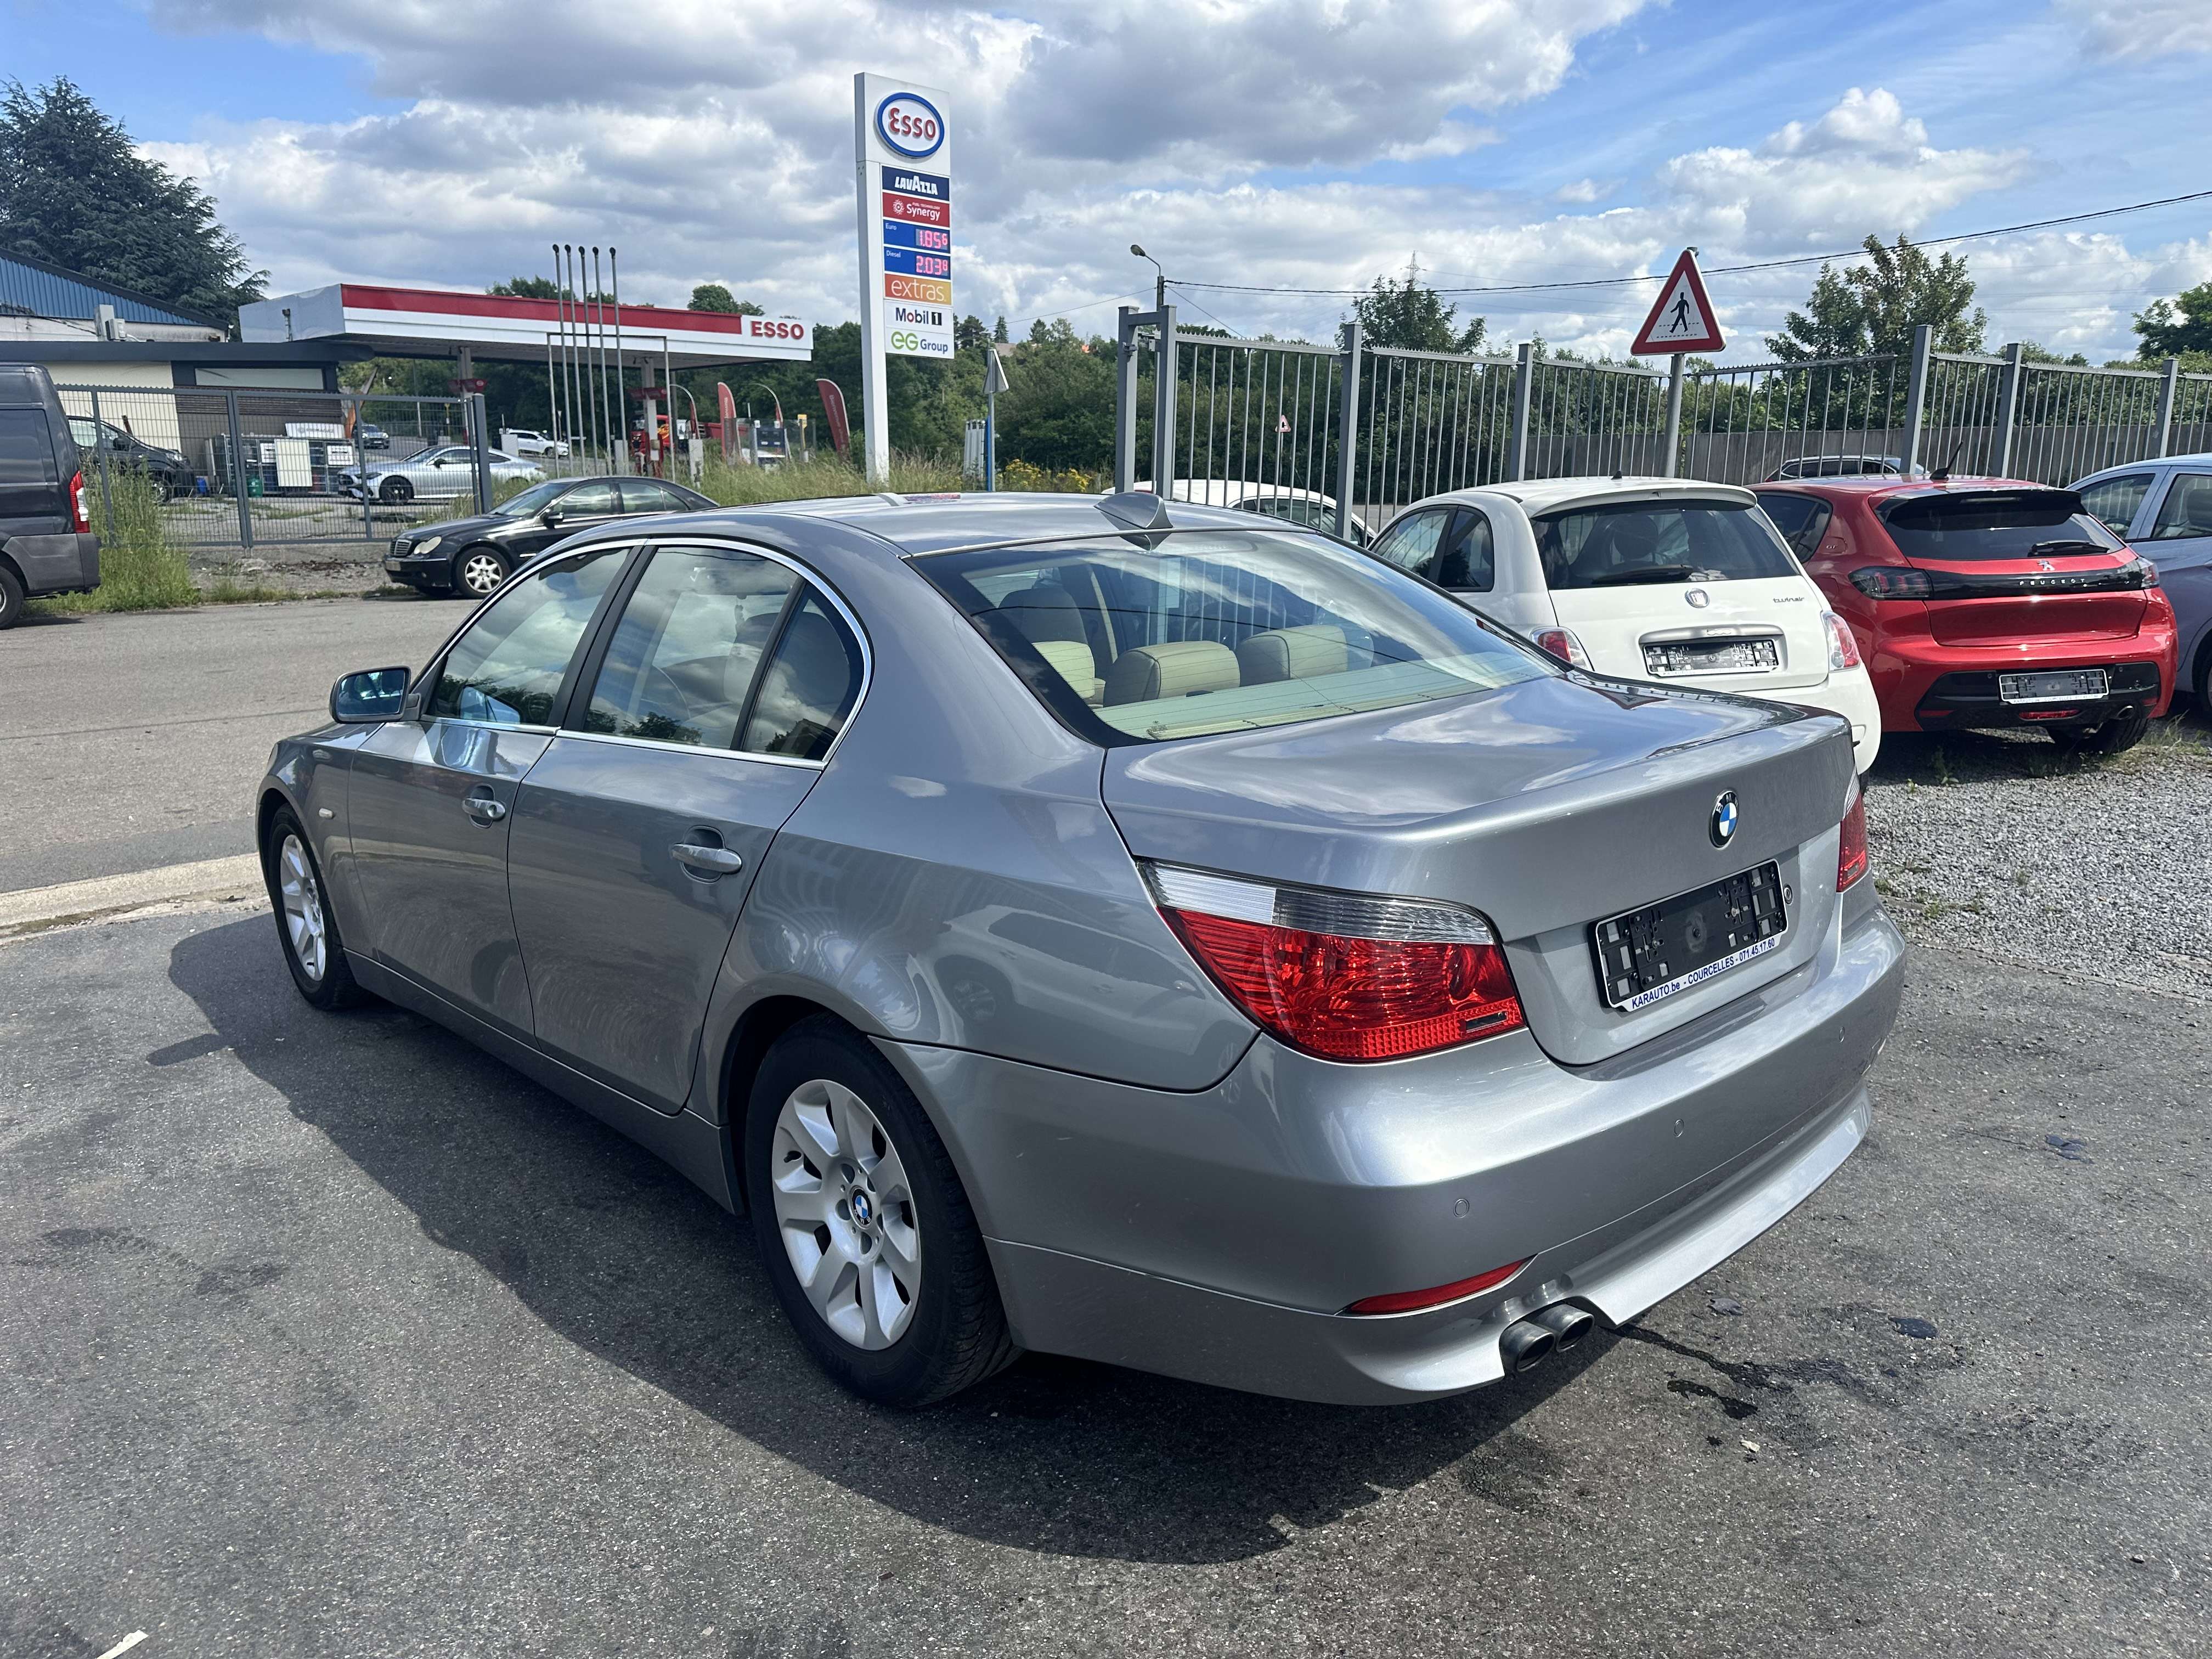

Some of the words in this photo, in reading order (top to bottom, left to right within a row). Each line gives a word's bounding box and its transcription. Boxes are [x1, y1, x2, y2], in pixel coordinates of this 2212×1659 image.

[895, 176, 938, 195] LAVAZZA
[906, 204, 940, 221] Synergy
[891, 279, 944, 301] extras
[895, 307, 929, 324] Mobil
[933, 312, 940, 325] 1
[751, 321, 804, 340] ESSO
[920, 339, 948, 354] Group
[1632, 982, 1680, 1009] KARAUTO.be
[1688, 956, 1734, 984] COURCELLES
[1739, 938, 1775, 962] 071.45.17.60
